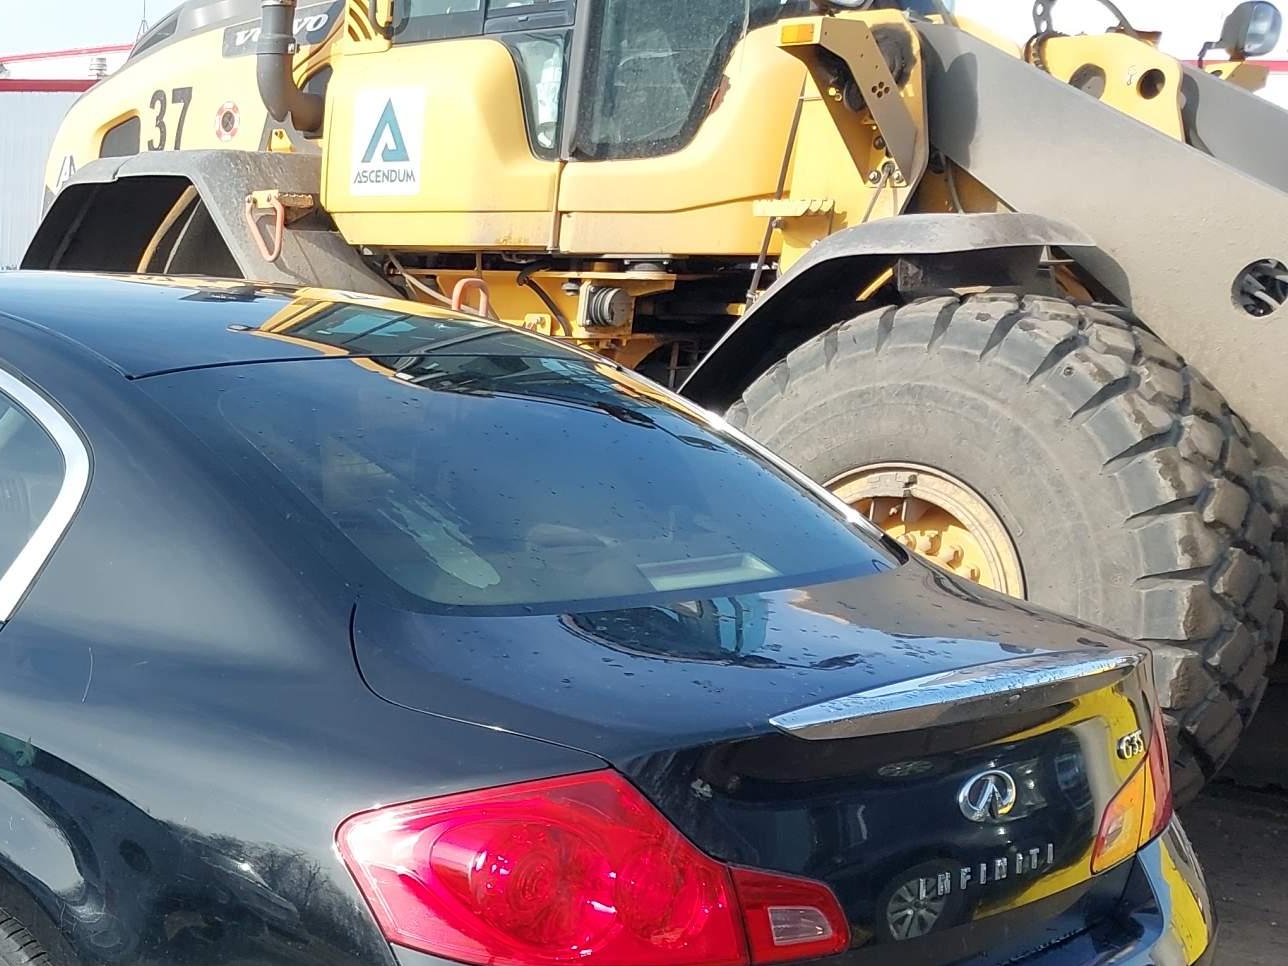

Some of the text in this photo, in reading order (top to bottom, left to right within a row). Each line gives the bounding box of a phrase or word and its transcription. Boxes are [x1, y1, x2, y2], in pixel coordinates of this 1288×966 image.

[235, 14, 328, 46] VVO
[148, 87, 192, 151] 37
[354, 169, 415, 184] ASCENDUM
[1118, 730, 1143, 759] G35
[919, 843, 1054, 900] INFINITI
